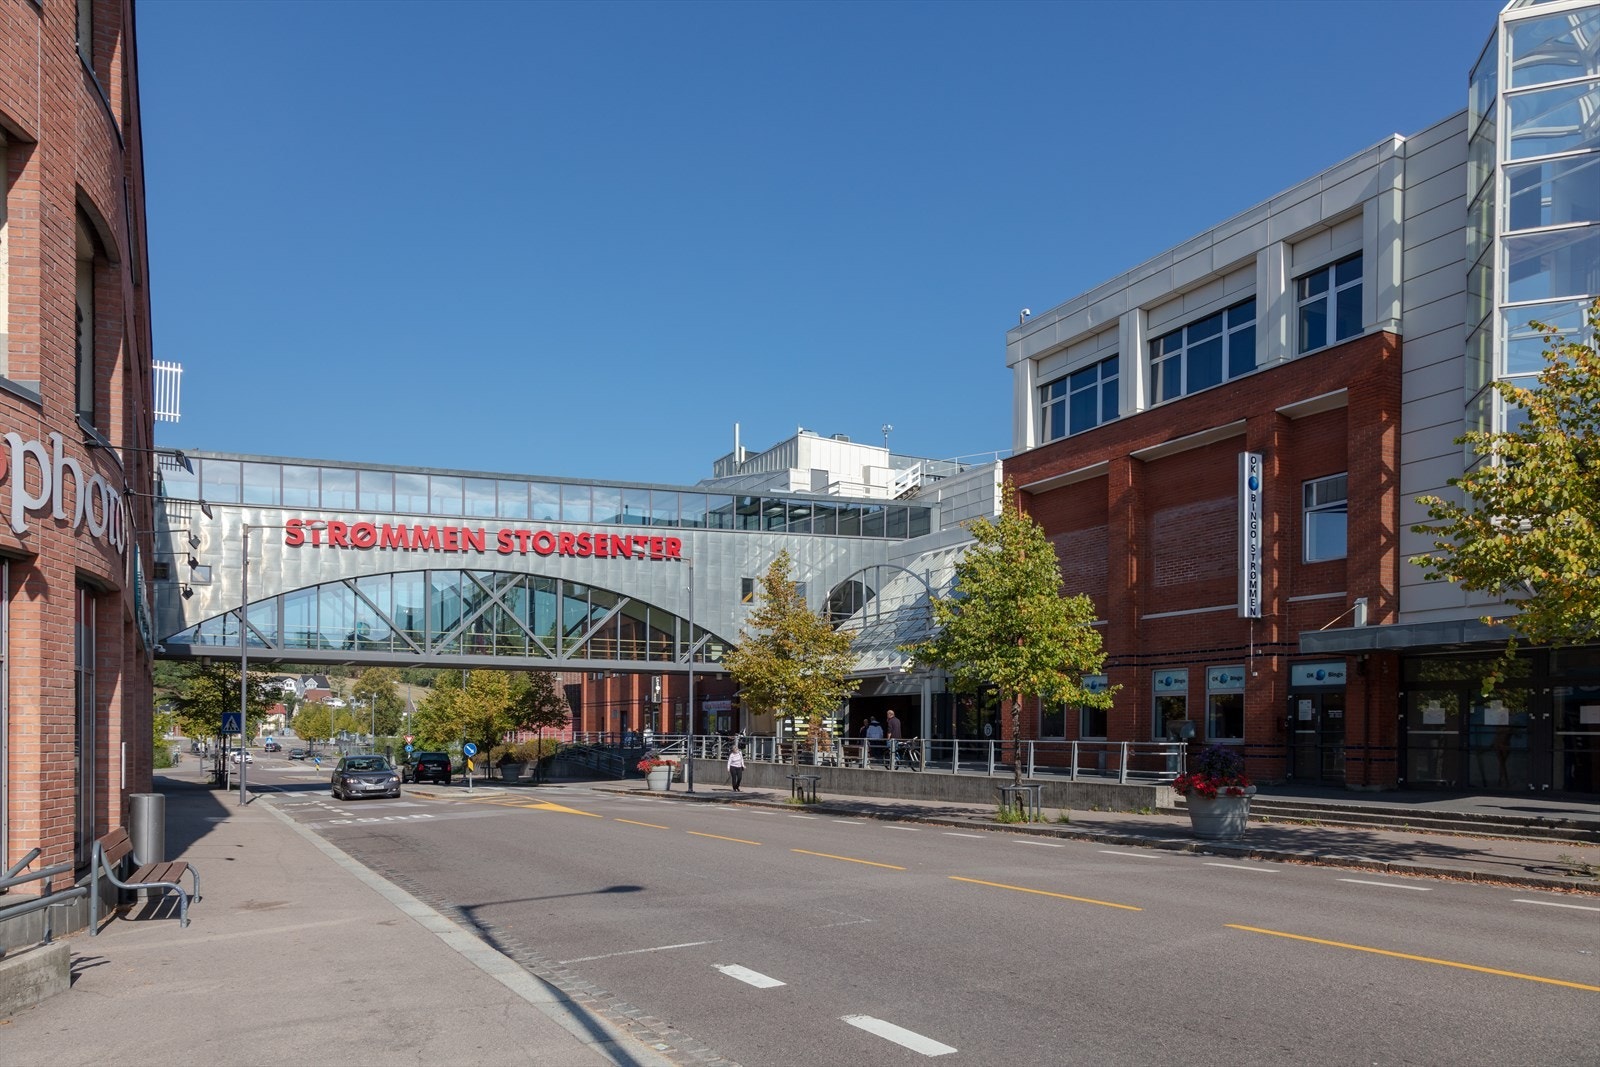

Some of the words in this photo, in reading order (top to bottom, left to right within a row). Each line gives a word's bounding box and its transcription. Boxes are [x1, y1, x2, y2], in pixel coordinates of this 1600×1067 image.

[1250, 456, 1257, 473] OK
[285, 518, 486, 553] STRØMMEN
[497, 528, 682, 561] STORSENTER
[1249, 544, 1257, 616] STRØMMEN
